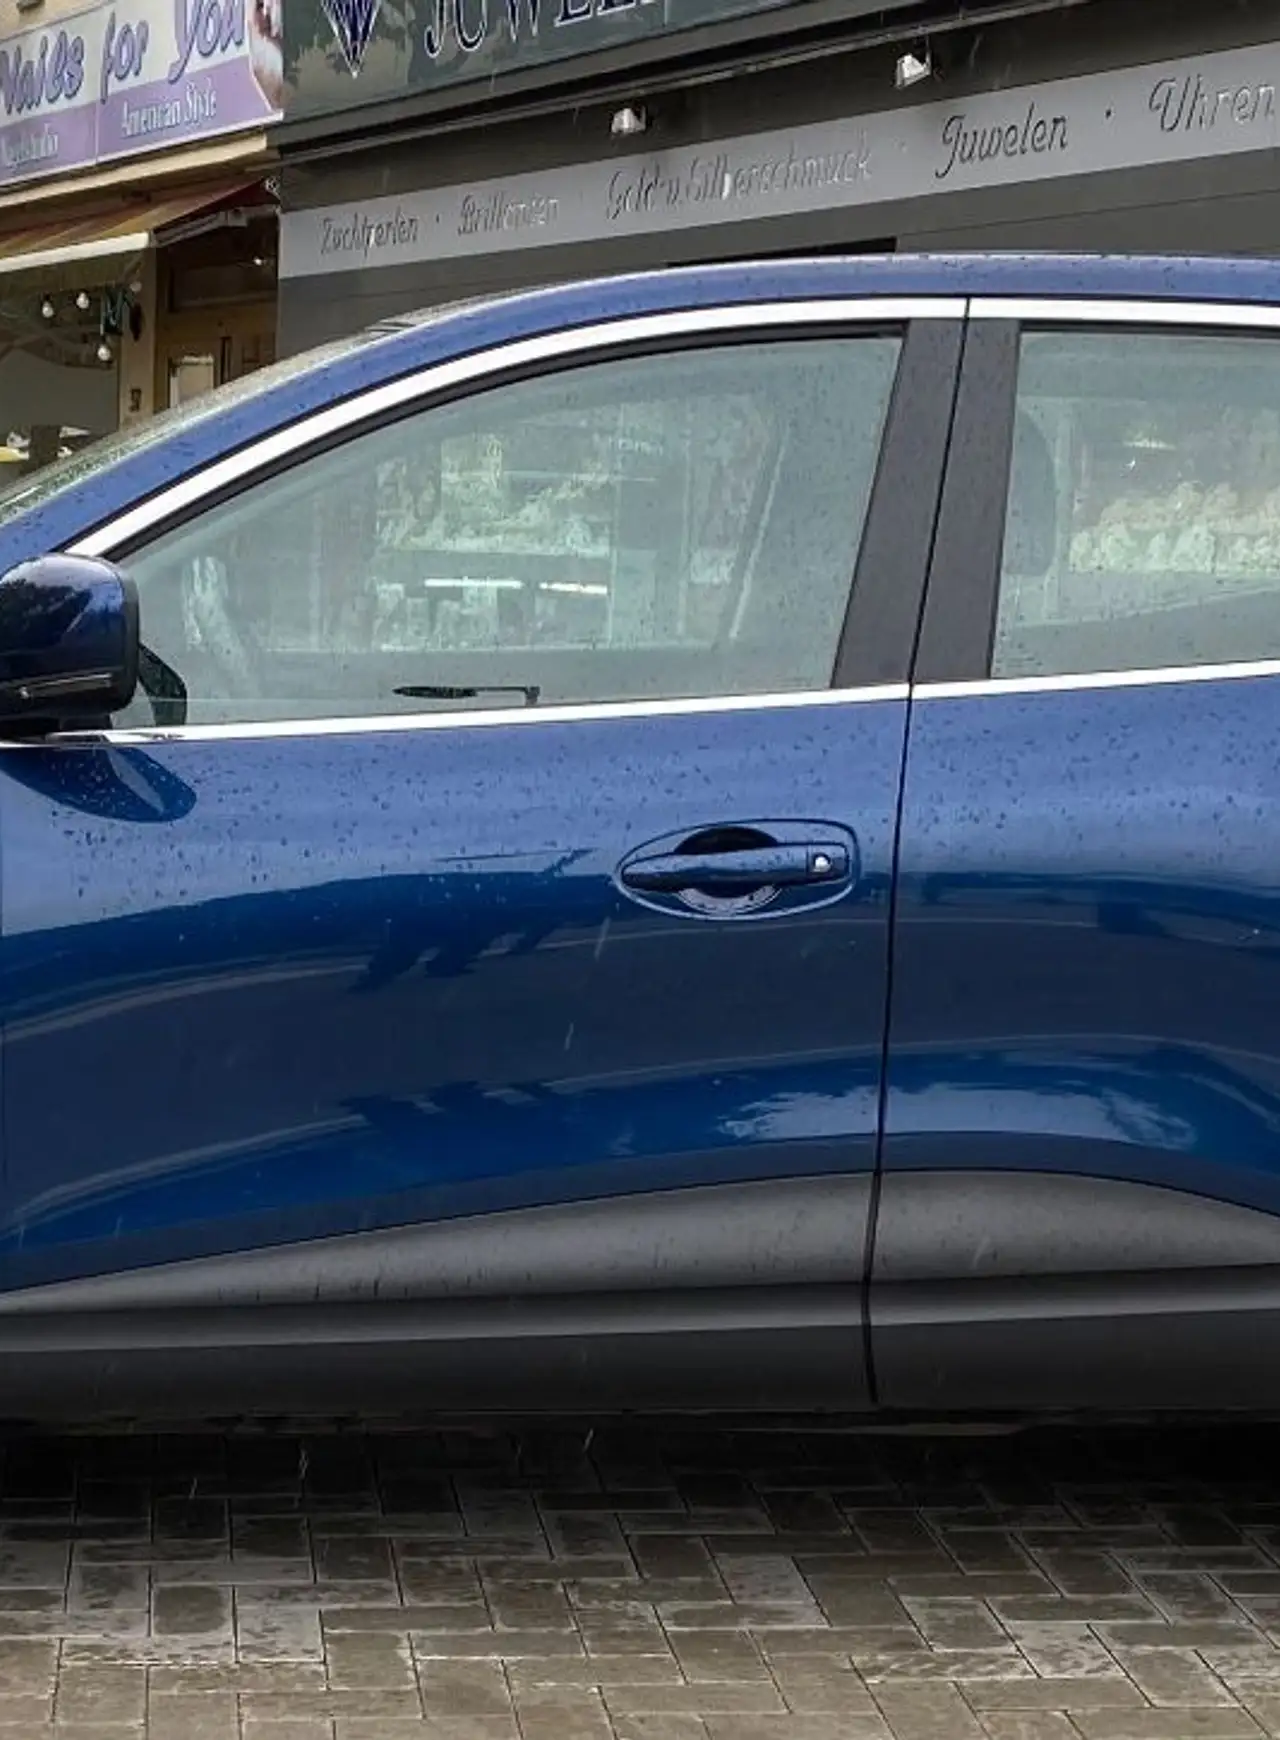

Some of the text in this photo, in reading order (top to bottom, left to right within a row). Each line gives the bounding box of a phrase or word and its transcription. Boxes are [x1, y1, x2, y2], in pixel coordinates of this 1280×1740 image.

[100, 11, 150, 104] for
[935, 102, 1068, 179] Juwelen
[1149, 73, 1276, 132] Uhren
